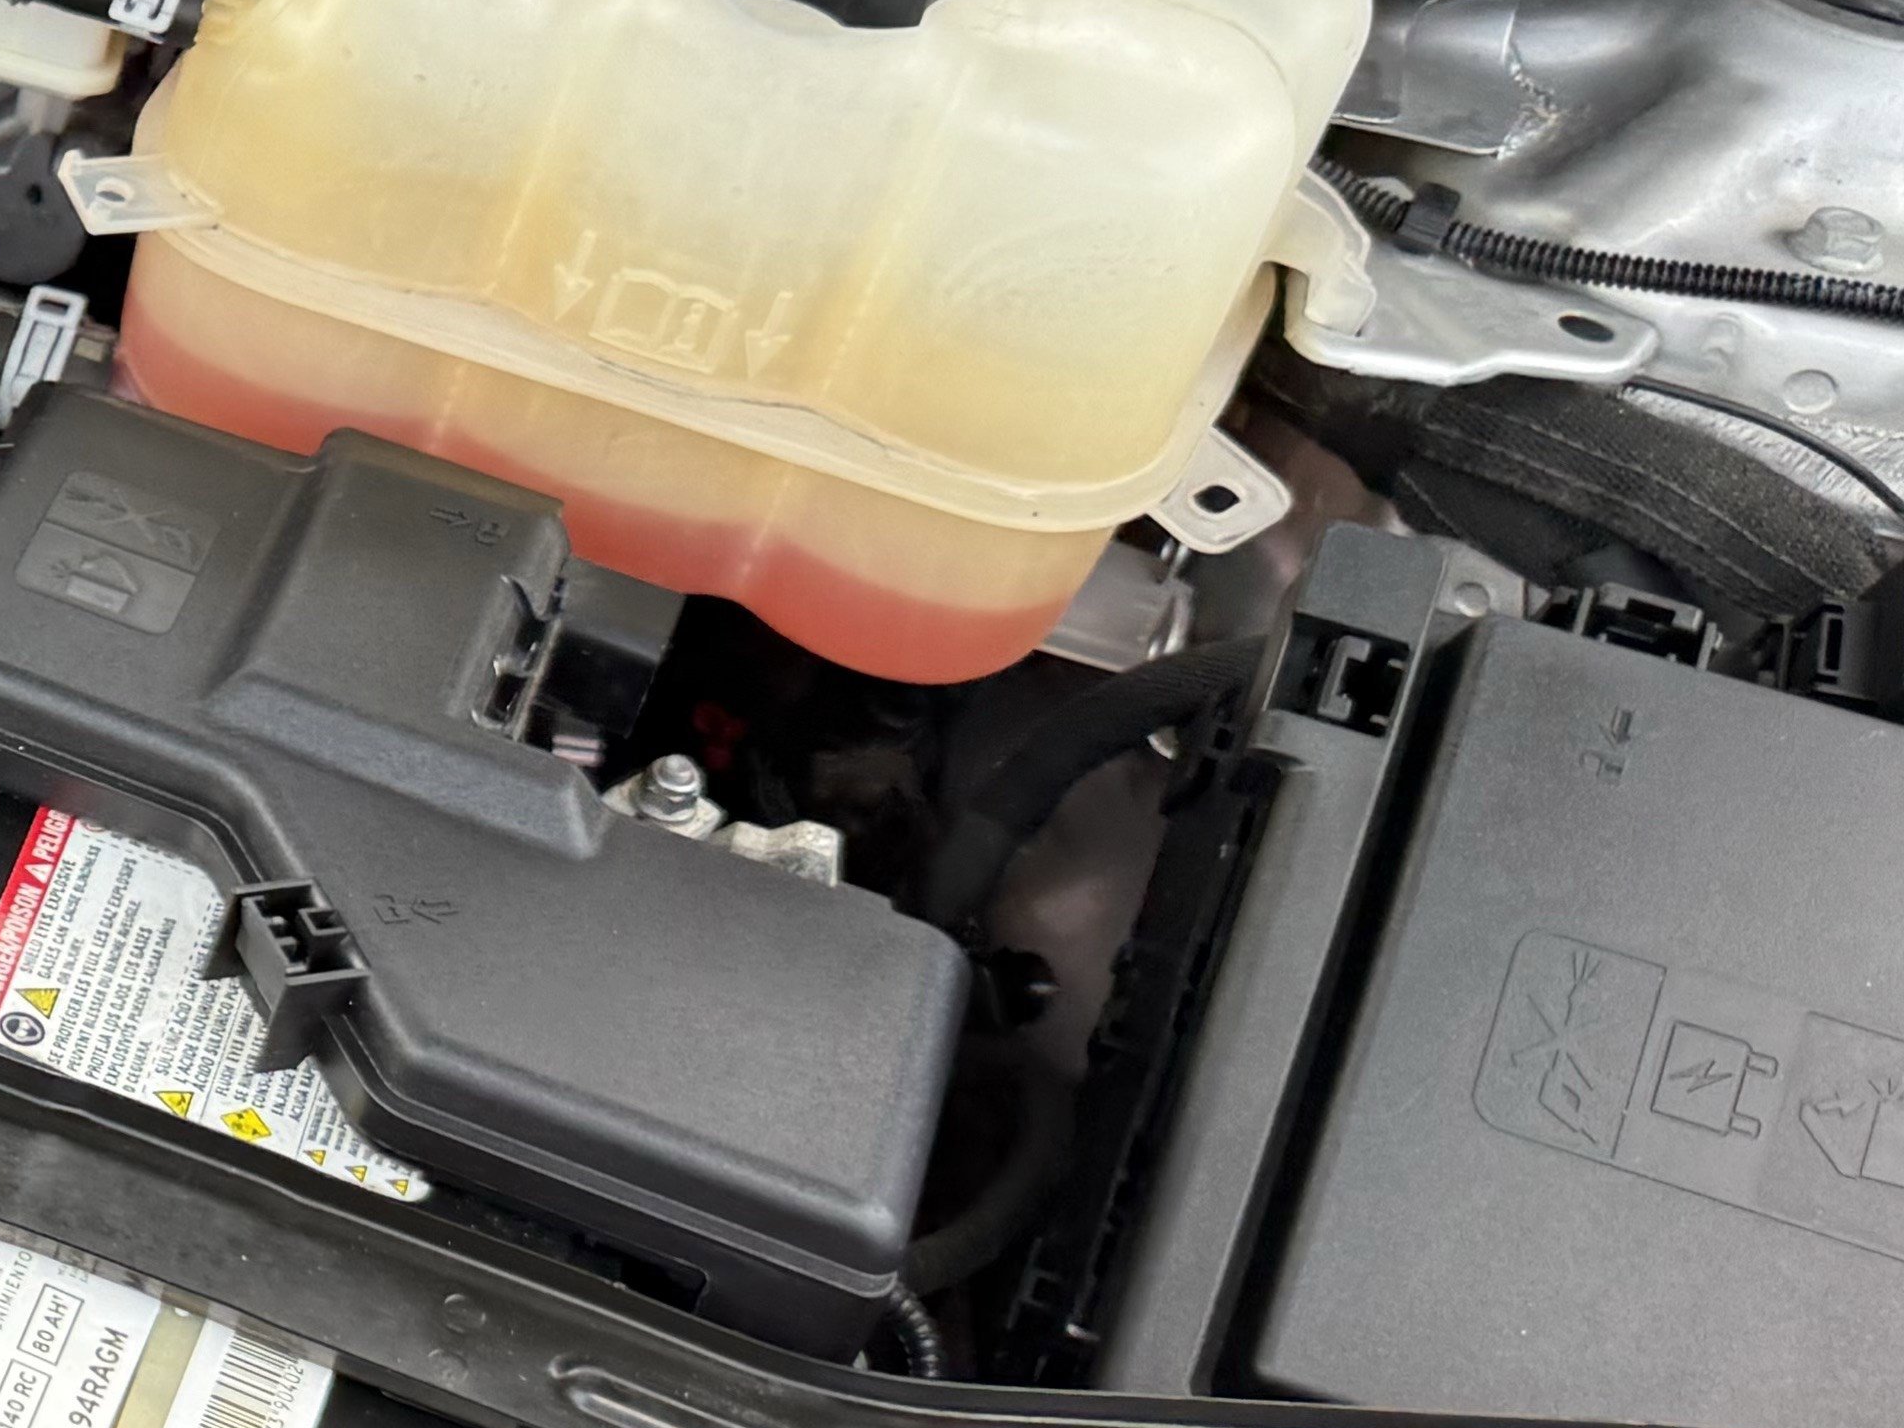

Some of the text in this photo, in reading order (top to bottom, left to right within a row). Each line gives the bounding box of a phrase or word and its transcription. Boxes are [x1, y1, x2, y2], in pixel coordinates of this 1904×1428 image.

[43, 857, 76, 911] EXPLOSIVE
[37, 945, 61, 980] GASES
[50, 923, 70, 946] CAN
[128, 924, 154, 960] GASES
[120, 957, 141, 981] LOS
[45, 1049, 63, 1066] SE
[71, 976, 91, 999] LES
[90, 927, 110, 949] LES
[171, 1000, 193, 1027] ACID
[28, 1325, 56, 1354] 80
[11, 1369, 38, 1397] RC
